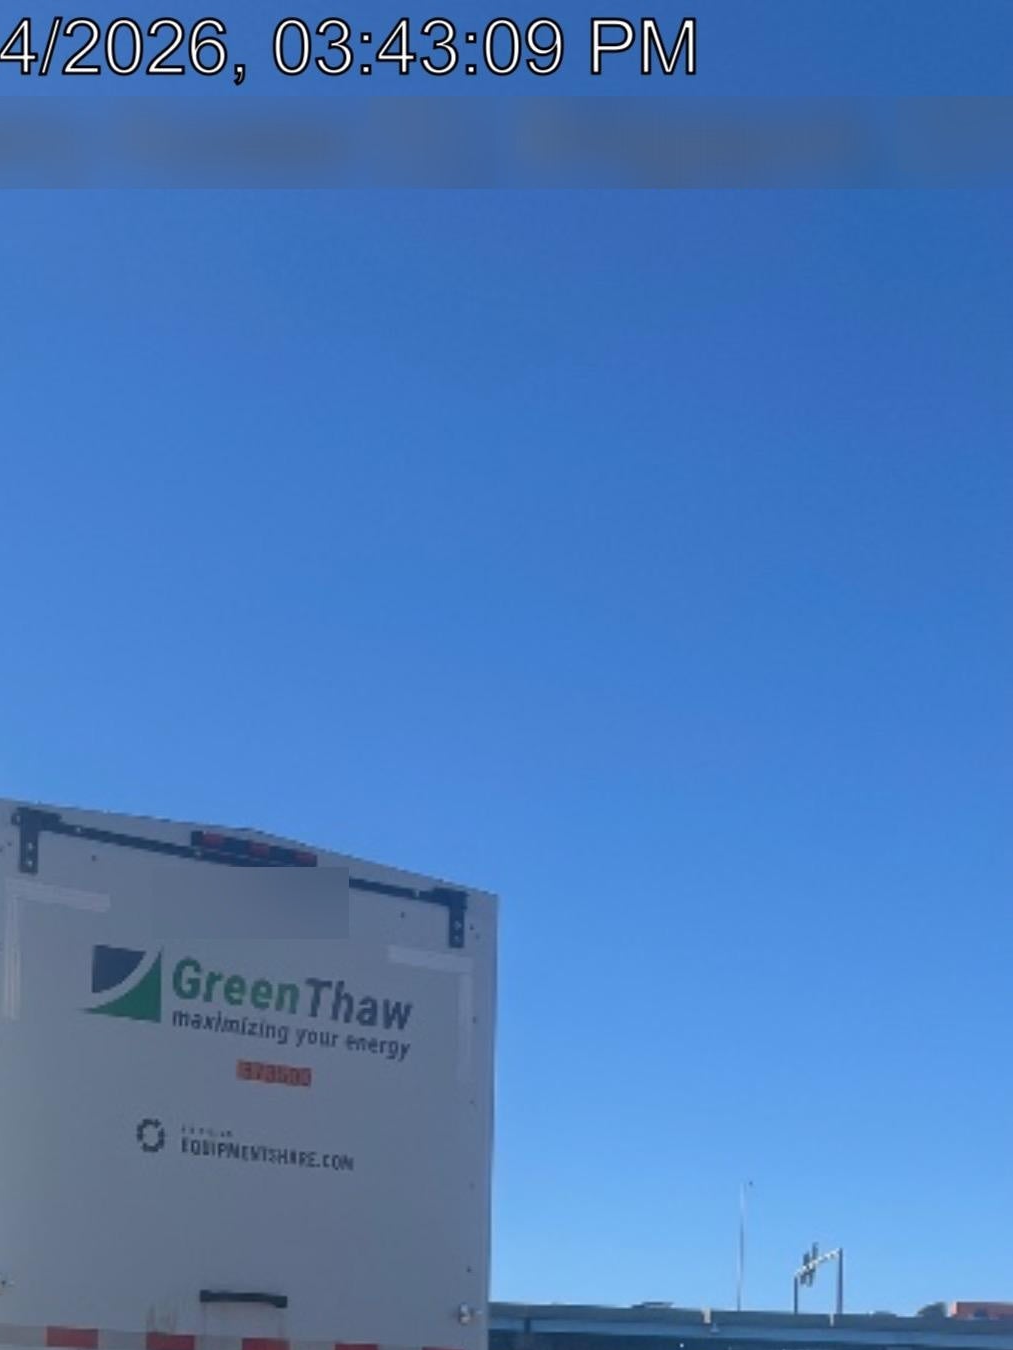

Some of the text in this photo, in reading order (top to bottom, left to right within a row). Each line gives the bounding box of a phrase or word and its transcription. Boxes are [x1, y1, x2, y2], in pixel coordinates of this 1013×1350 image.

[172, 956, 413, 1031] GreenThaw
[172, 1010, 411, 1061] maximizing your energy
[180, 1137, 354, 1171] EQUIPMENTSHARE.COM
